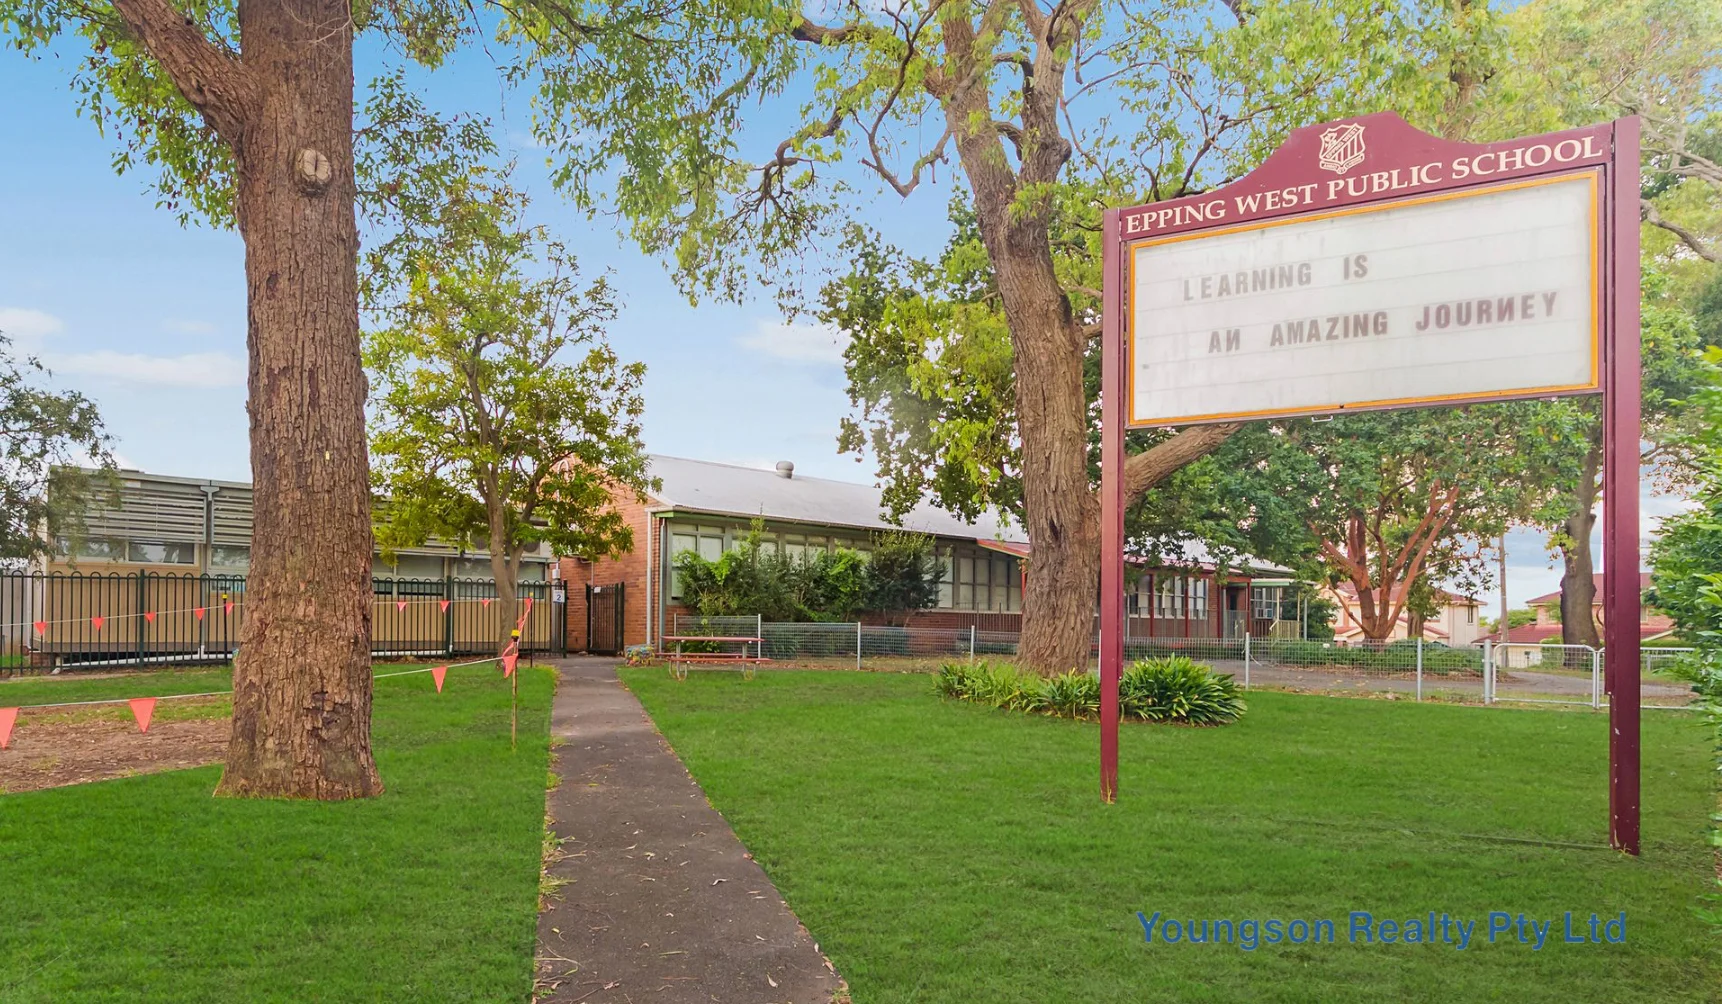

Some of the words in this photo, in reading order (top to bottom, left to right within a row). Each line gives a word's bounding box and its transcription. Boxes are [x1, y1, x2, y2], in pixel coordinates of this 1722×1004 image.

[1126, 200, 1226, 234] EPPING
[1234, 183, 1318, 215] WEST
[1327, 162, 1443, 200] PUBLIC
[1452, 136, 1603, 179] SCHOOL
[1183, 263, 1312, 301] LEARNING
[1343, 254, 1368, 280] IS
[1208, 328, 1240, 354] AN
[1269, 311, 1388, 347] AMAZING
[1415, 292, 1557, 331] JOURNEY
